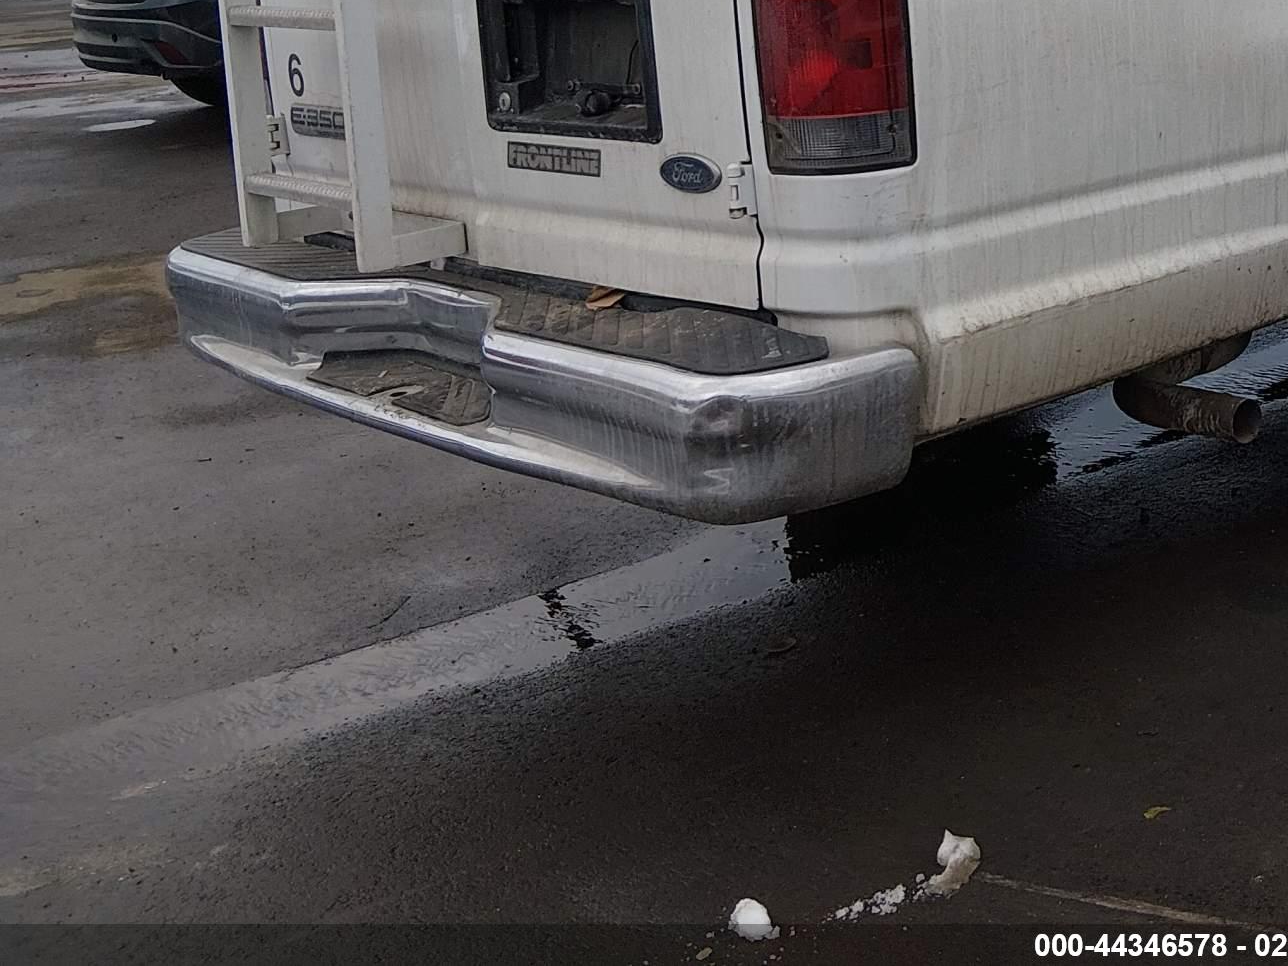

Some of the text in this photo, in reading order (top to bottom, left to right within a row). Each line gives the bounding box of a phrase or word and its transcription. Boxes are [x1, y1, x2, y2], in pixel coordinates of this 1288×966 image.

[289, 53, 304, 97] 6
[509, 144, 600, 175] FRONTLINE
[671, 162, 704, 184] Ford
